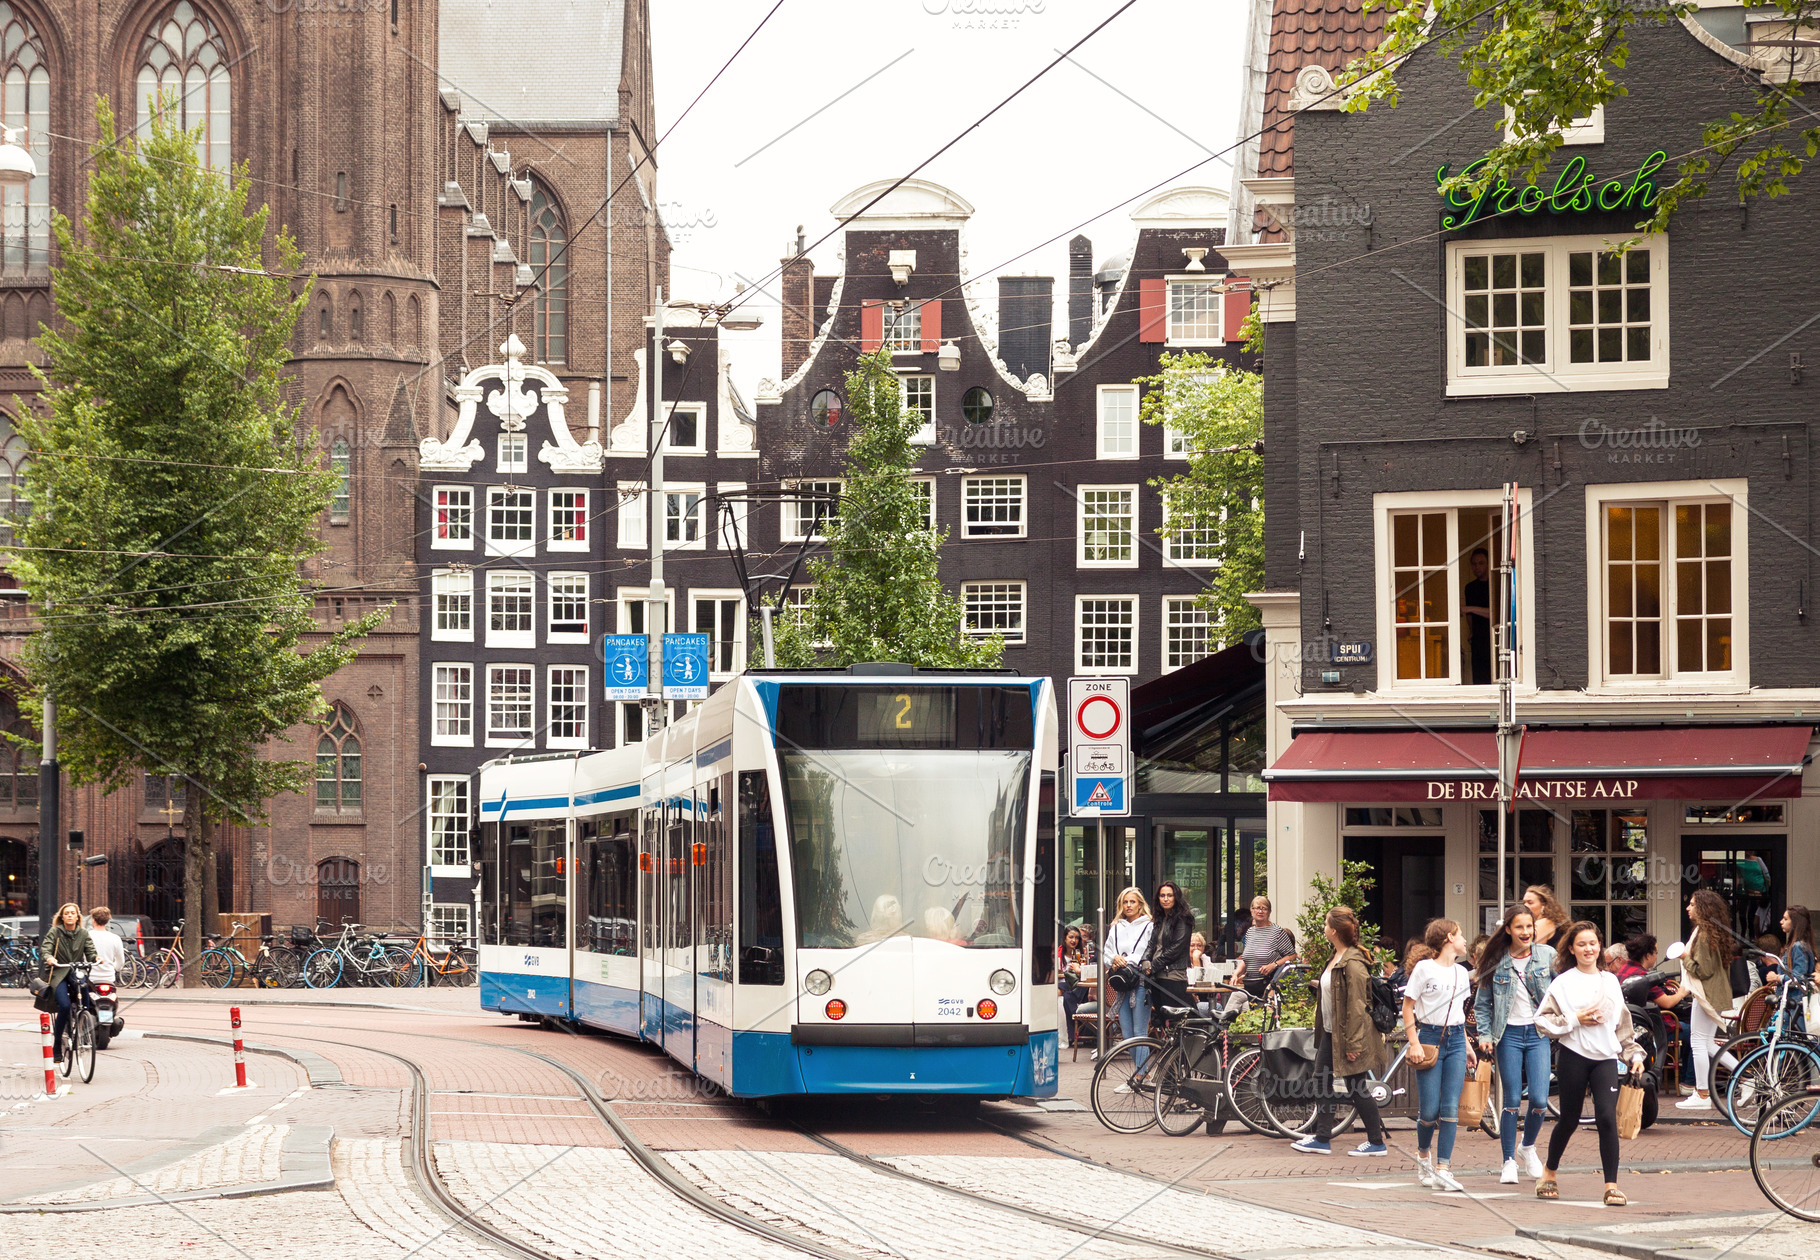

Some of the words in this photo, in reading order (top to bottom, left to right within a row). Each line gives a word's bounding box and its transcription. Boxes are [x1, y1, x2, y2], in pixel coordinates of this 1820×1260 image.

[1435, 150, 1667, 230] Grolsch
[606, 638, 645, 646] PANCAKES
[665, 637, 706, 645] PANCAKES
[1340, 644, 1361, 654] SPUI
[895, 694, 912, 728] 2
[1427, 781, 1455, 799] DE
[1461, 780, 1587, 799] BRAANTSE
[1591, 779, 1639, 798] AAP
[938, 1007, 961, 1016] 2042
